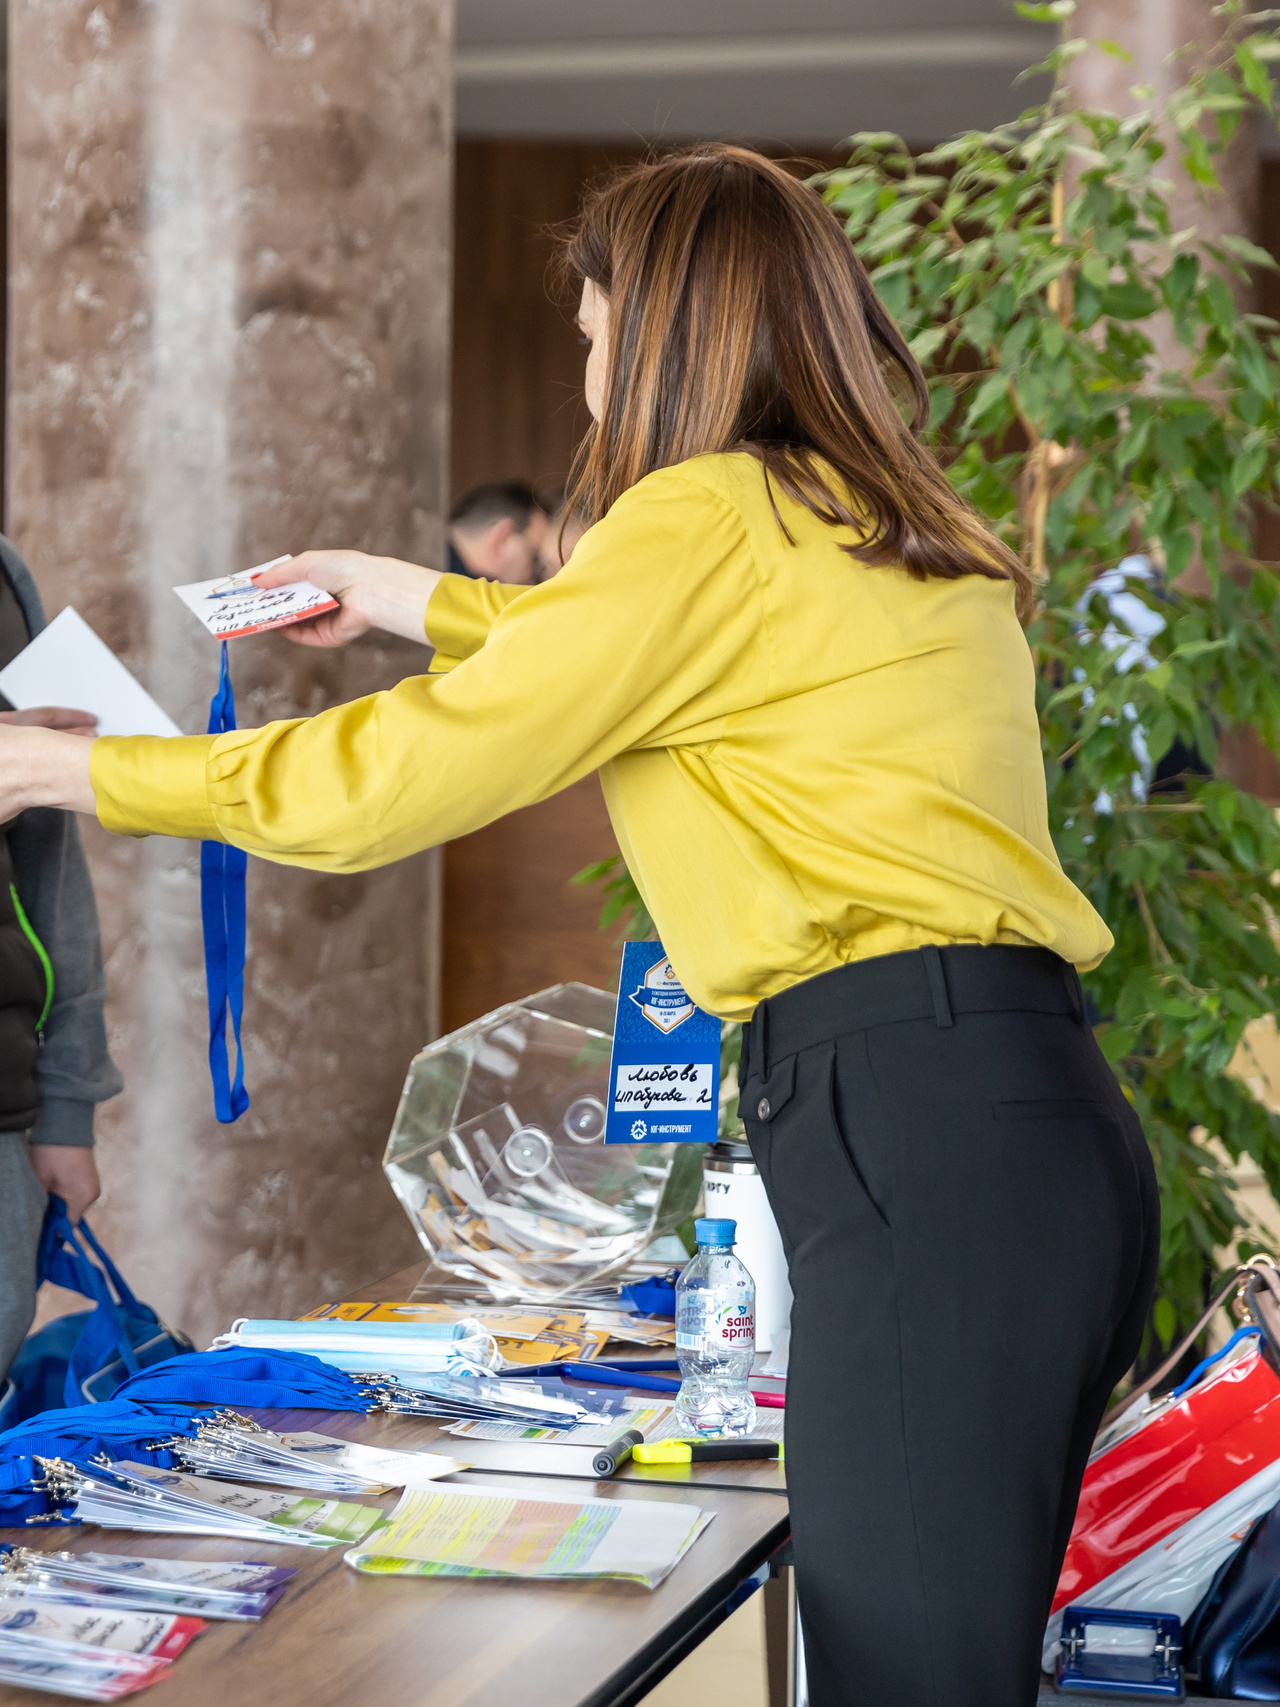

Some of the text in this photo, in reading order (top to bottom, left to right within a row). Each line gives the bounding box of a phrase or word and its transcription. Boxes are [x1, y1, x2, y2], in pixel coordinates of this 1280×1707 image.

[650, 996, 687, 1007] ЮГ-ИНСТРУМЕНТ
[650, 1124, 692, 1134] ЮГ-ИНСТРУМЕНТ
[470, 1312, 523, 1321] 097
[726, 1314, 754, 1327] saint
[721, 1327, 755, 1342] spring
